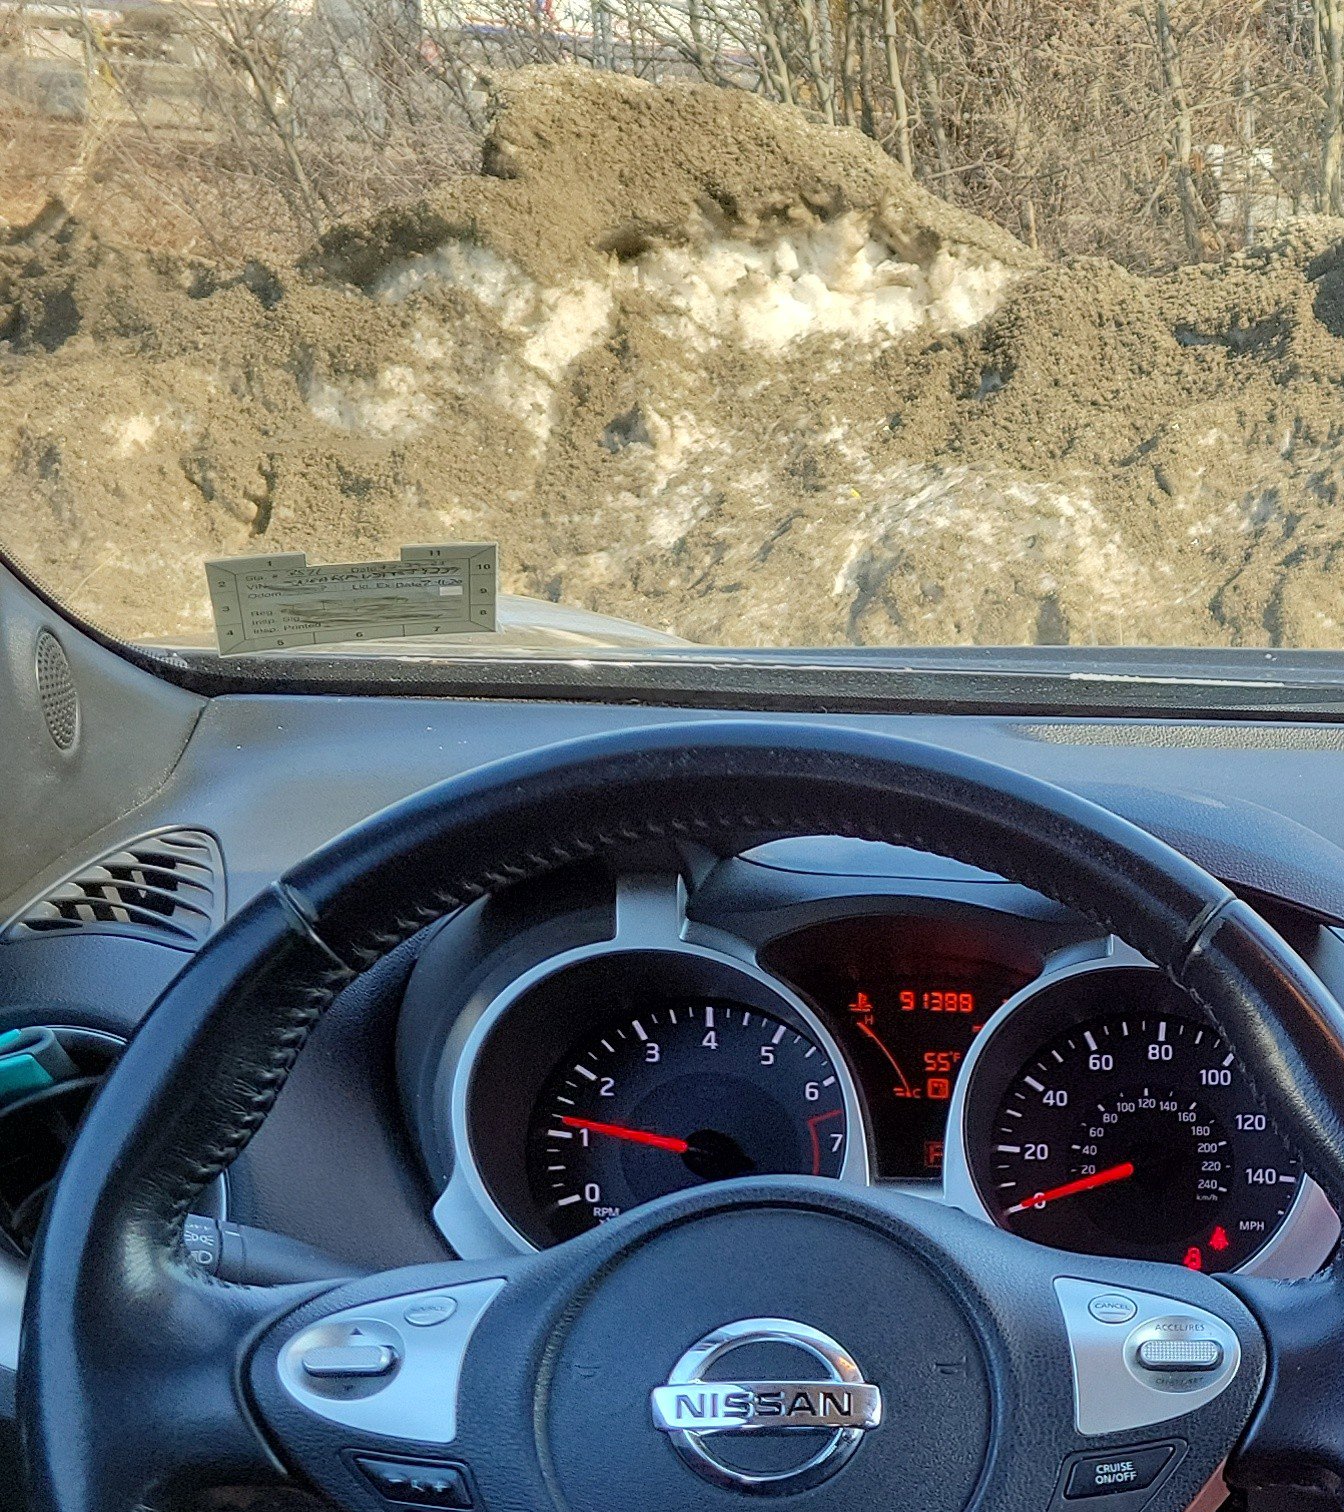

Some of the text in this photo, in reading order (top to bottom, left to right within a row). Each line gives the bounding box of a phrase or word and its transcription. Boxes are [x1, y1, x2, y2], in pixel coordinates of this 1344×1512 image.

[476, 562, 492, 571] 10
[701, 1030, 720, 1050] 4
[644, 1044, 662, 1064] 3
[760, 1046, 776, 1066] 5
[1147, 1042, 1174, 1063] 80
[1088, 1052, 1114, 1072] 60
[1199, 1066, 1233, 1086] 100
[600, 1078, 615, 1097] 2
[803, 1082, 820, 1101] 6
[1041, 1088, 1069, 1107] 40
[1138, 1098, 1156, 1109] 120
[1116, 1101, 1135, 1113] 100
[1159, 1100, 1178, 1112] 140
[1102, 1112, 1118, 1123] 80
[1178, 1111, 1197, 1122] 160
[1235, 1113, 1268, 1133] 120
[1089, 1126, 1104, 1138] 60
[1191, 1125, 1211, 1136] 180
[829, 1133, 844, 1152] 7
[1197, 1142, 1218, 1154] 200
[1024, 1142, 1050, 1162] 20
[1082, 1144, 1098, 1156] 40
[1081, 1164, 1096, 1175] 20
[1201, 1160, 1222, 1172] 220
[1245, 1167, 1277, 1187] 140
[1197, 1179, 1218, 1190] 240
[583, 1183, 600, 1204] 0
[592, 1206, 621, 1219] RPM
[1239, 1220, 1266, 1232] MPH
[1094, 1302, 1131, 1311] CANCEL
[1154, 1323, 1206, 1333] ACCEL/RES
[675, 1391, 853, 1419] NISSAN
[1095, 1460, 1133, 1475] CRUISE
[1094, 1470, 1137, 1485] ON/OFF
